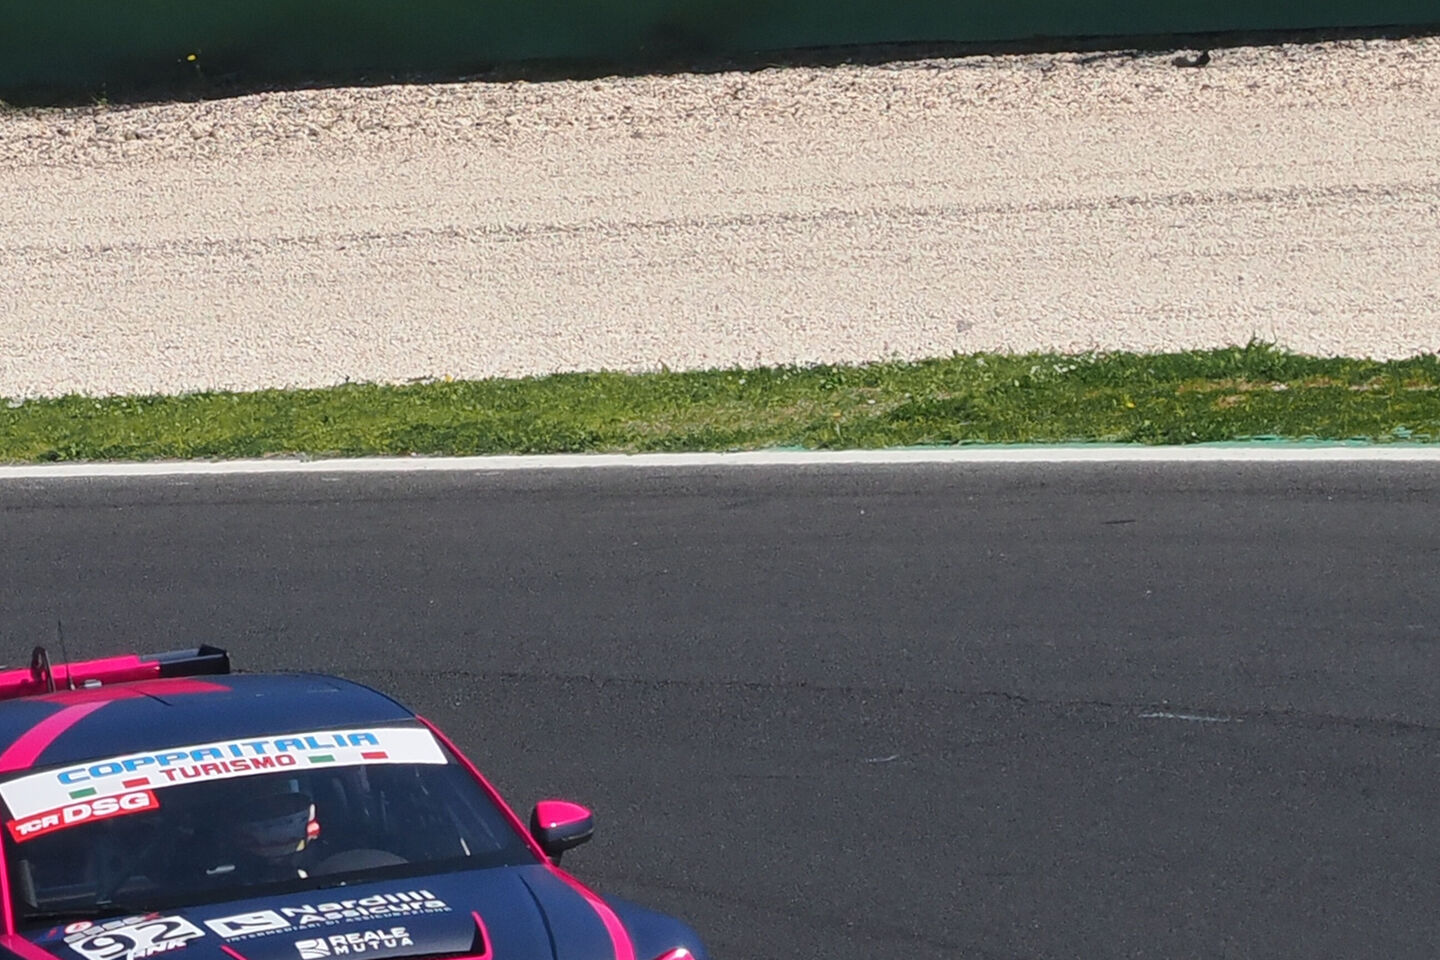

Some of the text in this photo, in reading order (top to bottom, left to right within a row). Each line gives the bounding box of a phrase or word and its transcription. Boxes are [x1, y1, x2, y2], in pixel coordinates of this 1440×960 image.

[160, 754, 297, 781] TURISMO
[15, 794, 150, 837] TCR DSG
[300, 900, 447, 926] Assicura
[81, 920, 197, 960] 92
[328, 926, 410, 946] REALE
[333, 937, 414, 956] MUTUA
